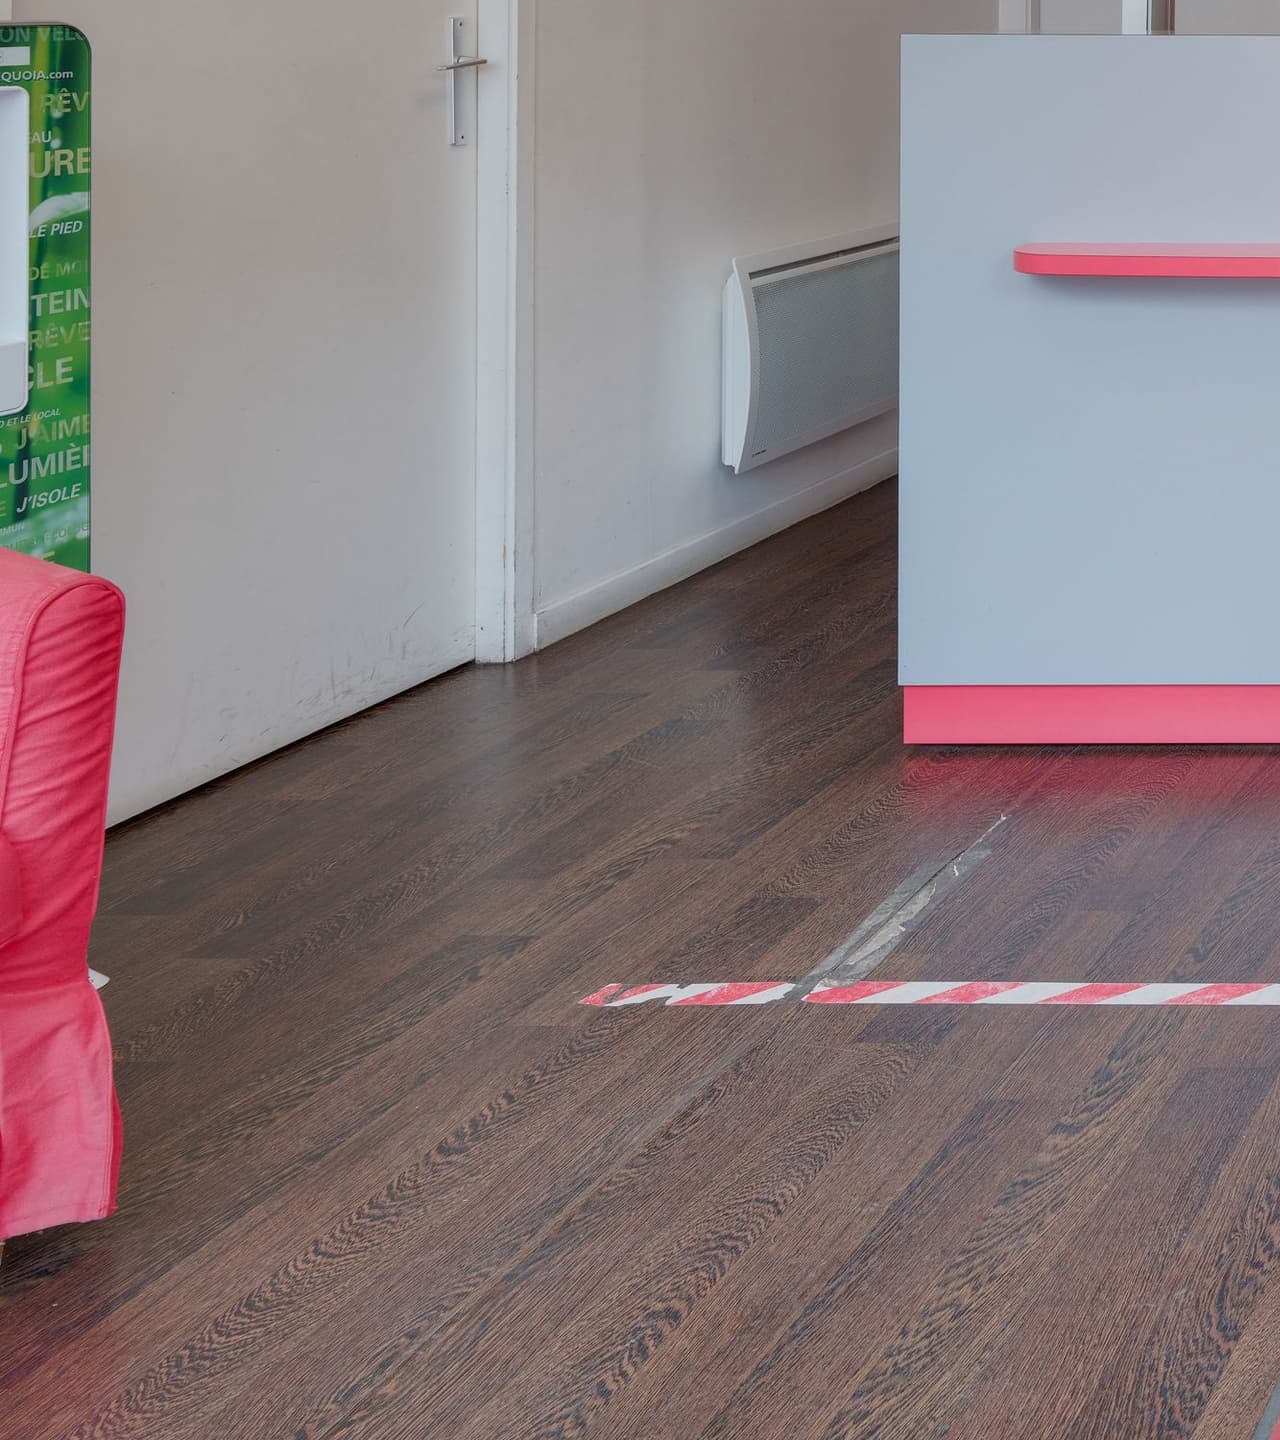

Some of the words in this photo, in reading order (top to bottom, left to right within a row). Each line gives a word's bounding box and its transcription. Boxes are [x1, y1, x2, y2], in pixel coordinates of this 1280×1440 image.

[0, 70, 74, 83] QUOIA.com
[50, 220, 83, 236] PIED
[16, 482, 81, 513] J'ISOLE
